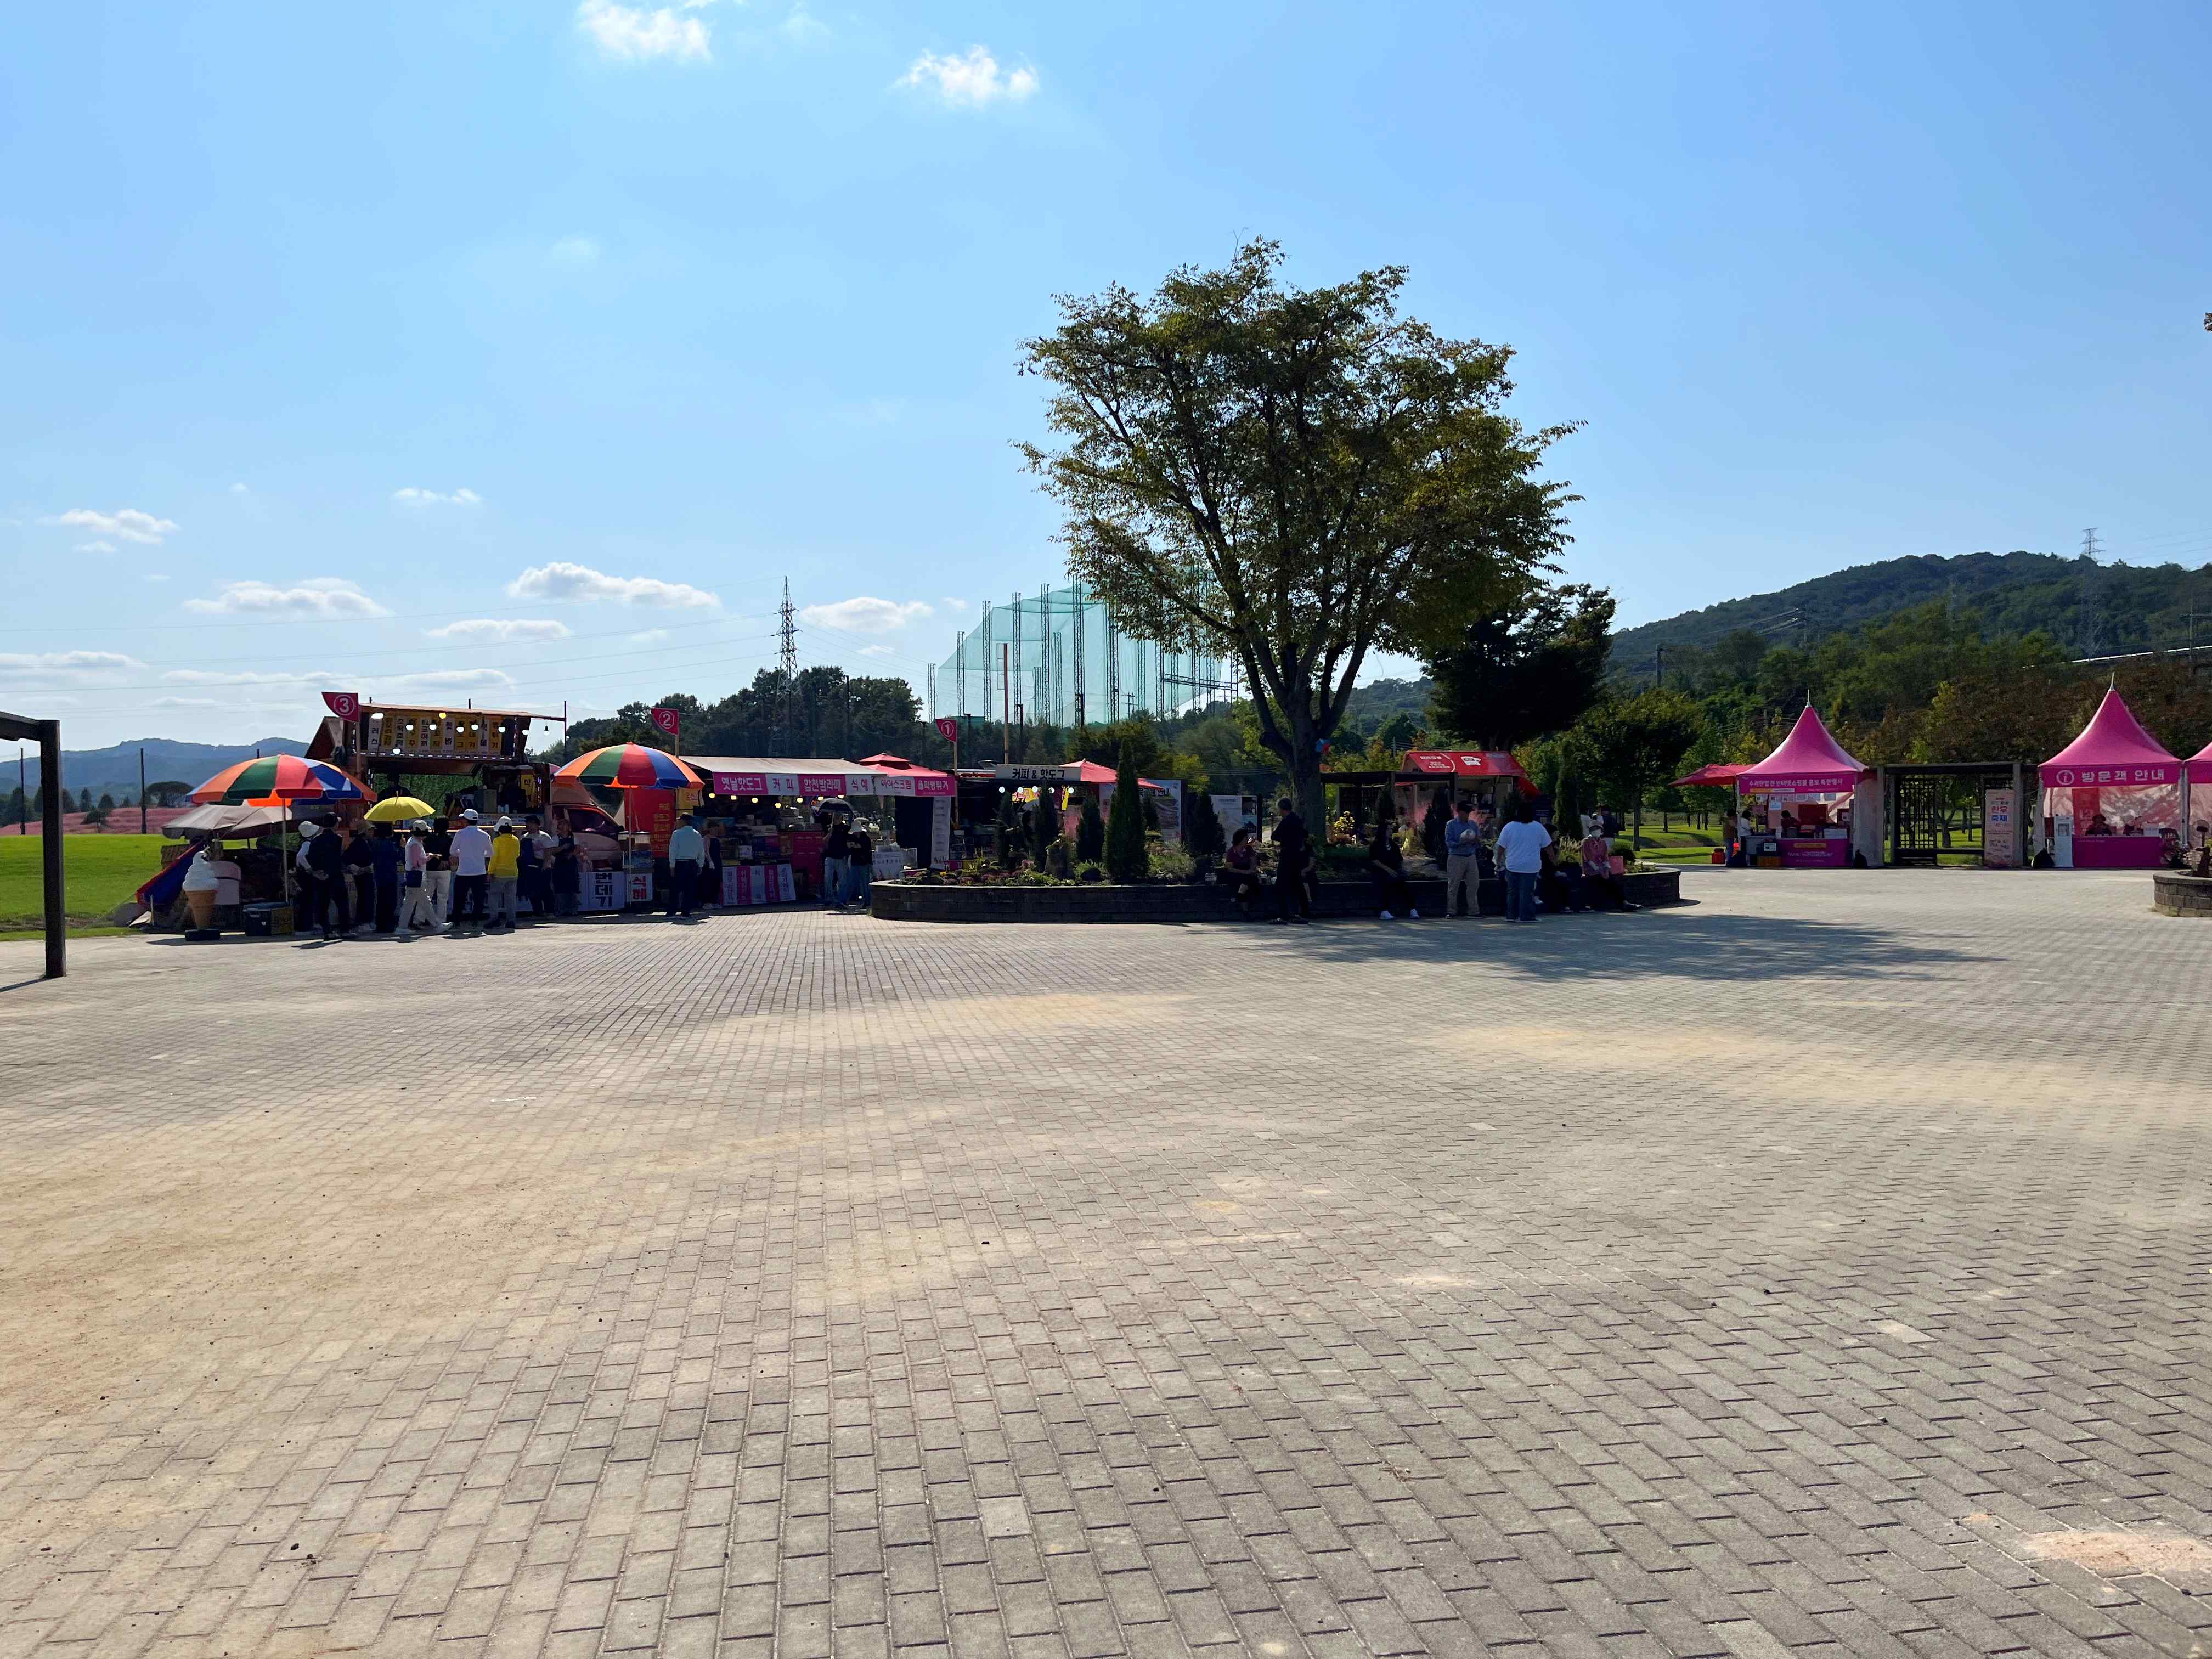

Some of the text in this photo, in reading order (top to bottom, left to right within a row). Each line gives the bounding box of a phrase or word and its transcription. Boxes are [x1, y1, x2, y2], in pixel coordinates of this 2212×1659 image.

[1012, 768, 1065, 780] 커피 & 핫도그
[2081, 769, 2165, 783] 방문객 안내
[721, 776, 763, 791] 옛날핫도그
[881, 779, 912, 790] 아이스크림
[595, 873, 612, 907] 번데기
